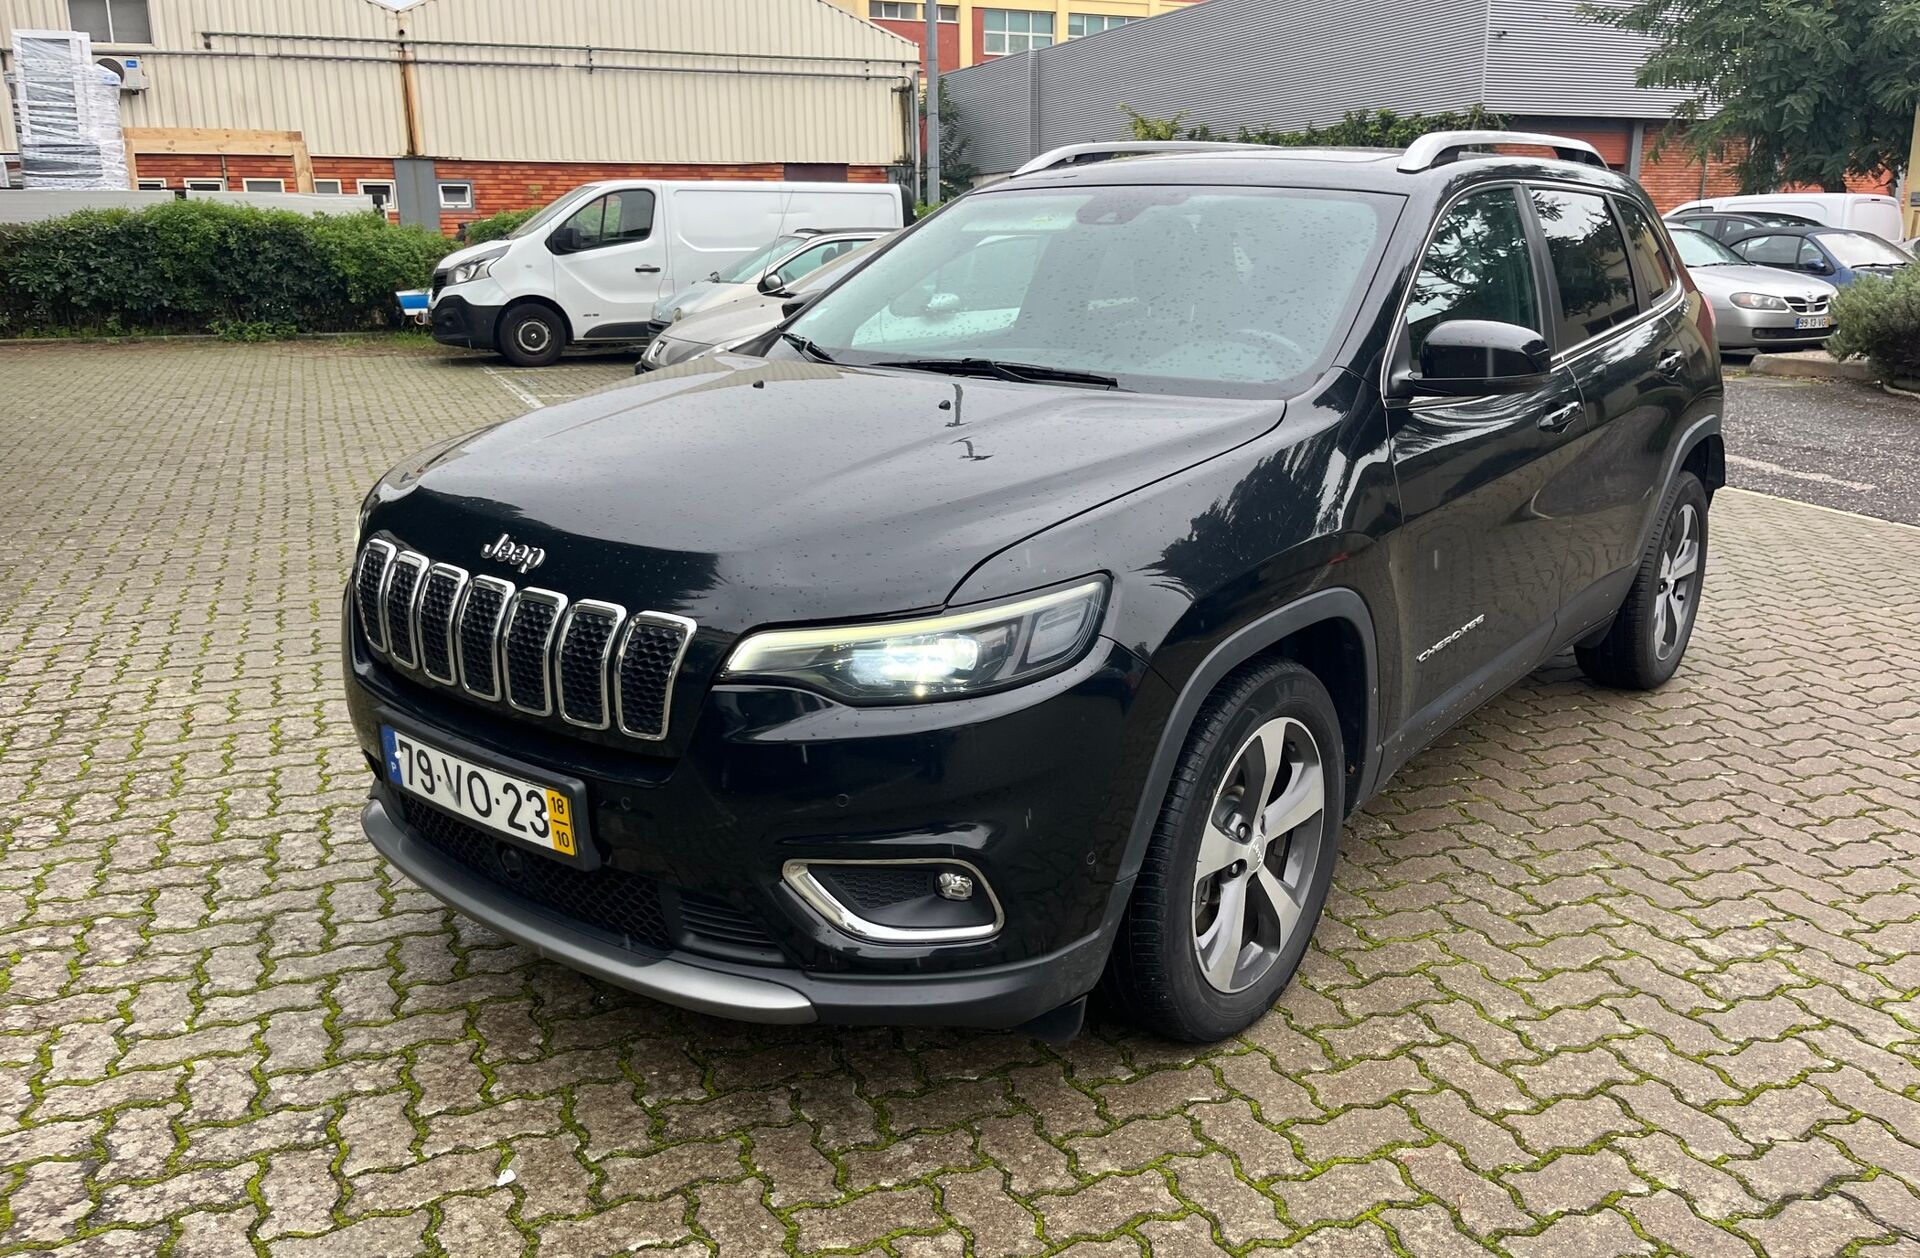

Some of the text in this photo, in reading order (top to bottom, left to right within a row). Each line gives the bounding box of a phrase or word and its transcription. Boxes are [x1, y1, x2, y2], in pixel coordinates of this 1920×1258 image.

[480, 533, 546, 575] Jeep
[1416, 613, 1485, 662] CHEROKEE
[390, 761, 397, 773] P
[551, 796, 565, 815] 18
[556, 830, 570, 848] 10
